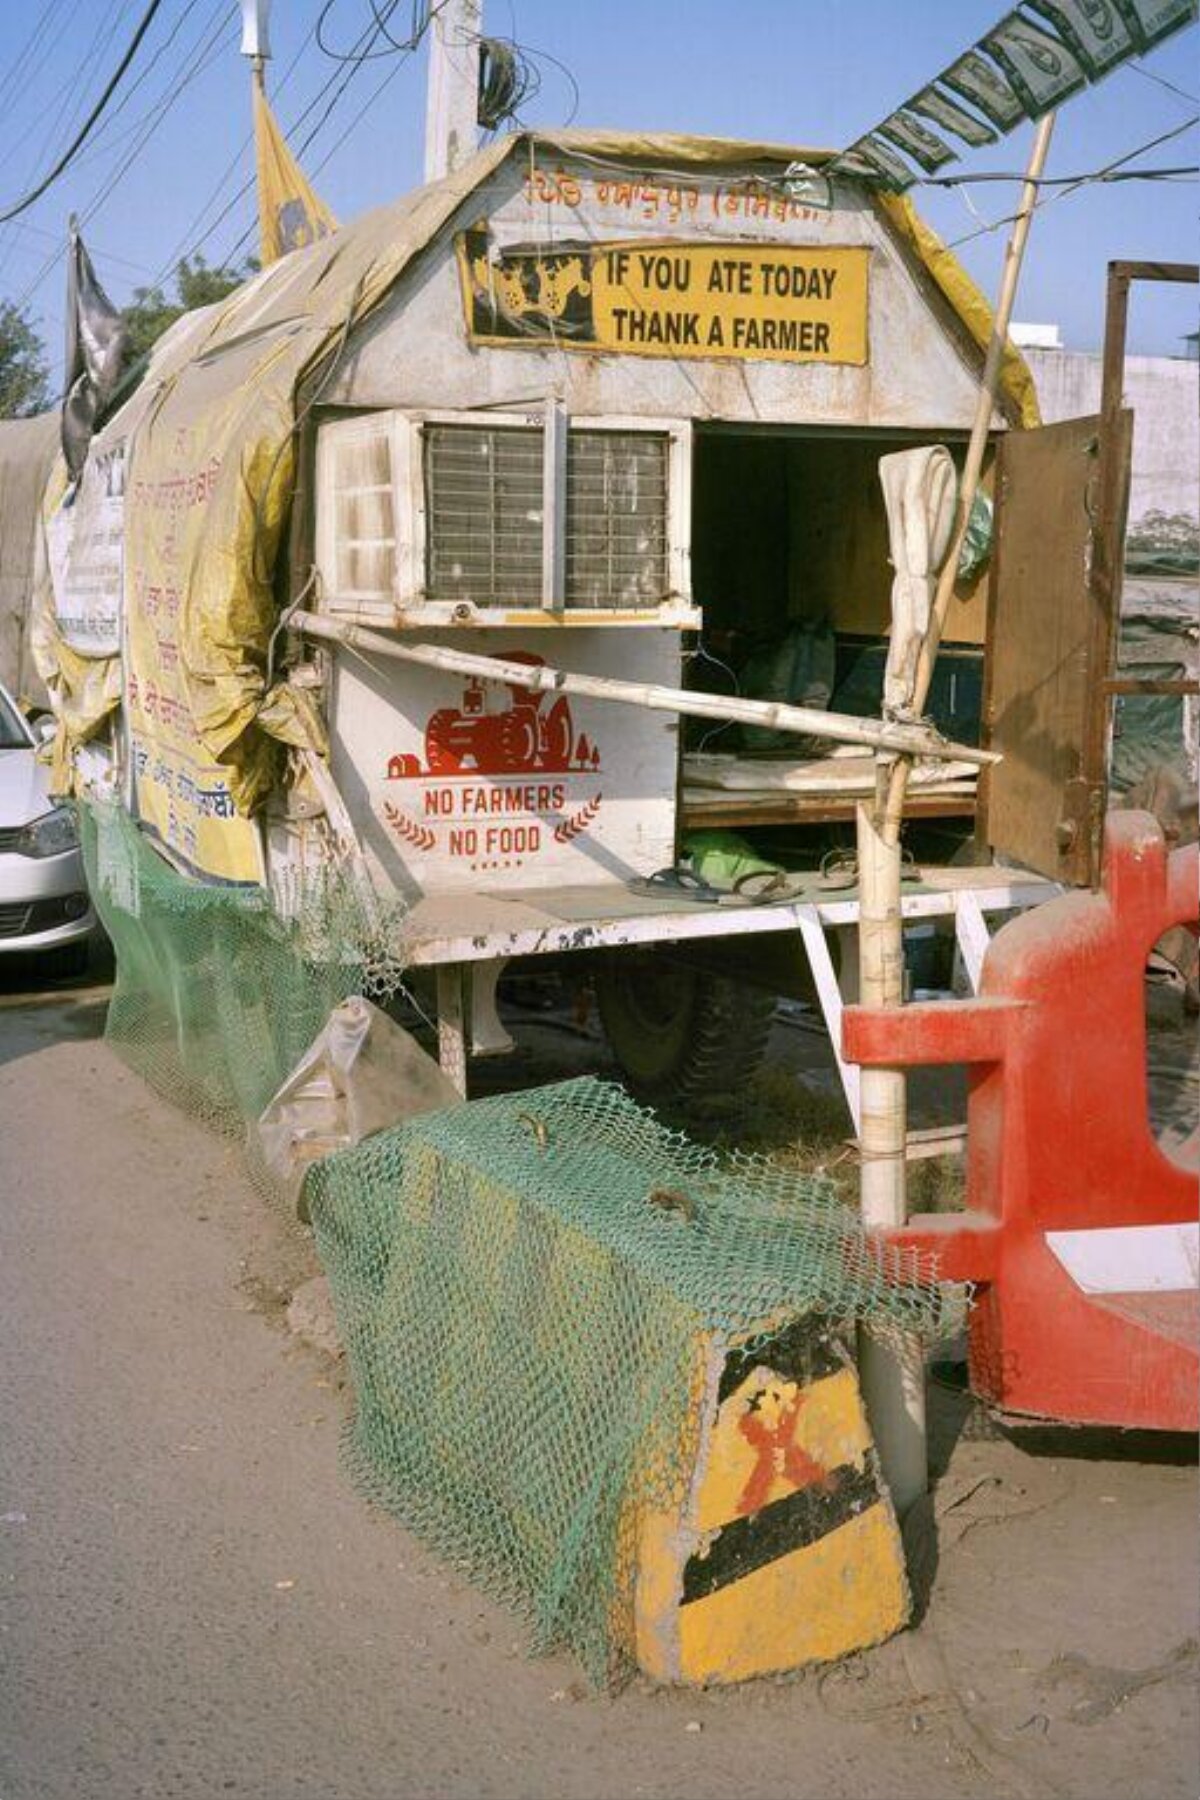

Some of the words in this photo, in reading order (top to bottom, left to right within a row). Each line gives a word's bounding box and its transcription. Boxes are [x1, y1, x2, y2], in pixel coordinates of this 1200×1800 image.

[607, 252, 630, 286] IF
[639, 255, 690, 292] YOU
[708, 261, 752, 296] ATE
[760, 265, 837, 300] TODAY
[612, 308, 699, 345] THANK
[707, 316, 724, 347] A
[733, 318, 831, 353] FARMER
[425, 789, 453, 815] NO
[462, 784, 565, 814] FARMERS
[450, 830, 477, 855] NO
[486, 826, 540, 853] FOOD
